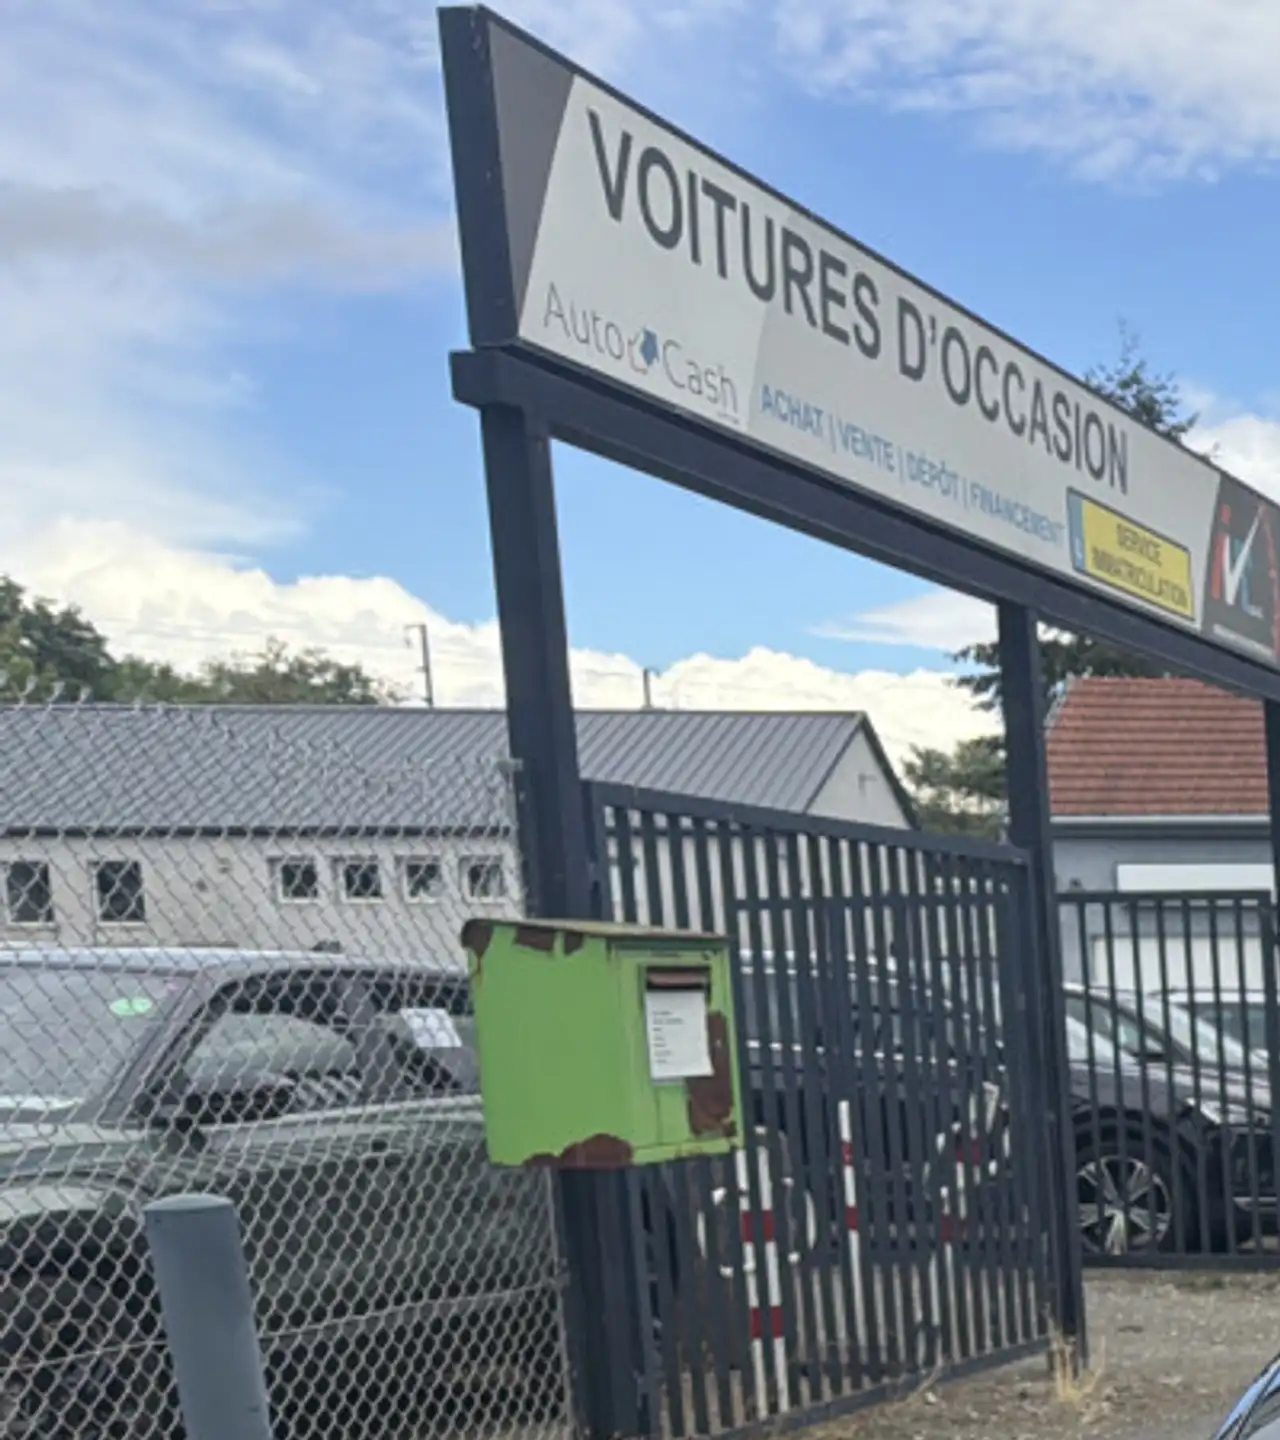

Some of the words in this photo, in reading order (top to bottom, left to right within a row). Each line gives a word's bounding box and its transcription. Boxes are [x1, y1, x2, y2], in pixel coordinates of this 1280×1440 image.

[543, 281, 625, 360] Auto
[662, 338, 738, 413] Cash
[588, 108, 881, 360] VOITURES
[897, 295, 1129, 496] D'OCCASION
[760, 384, 824, 437] ACHAT
[839, 420, 896, 472] VENTE
